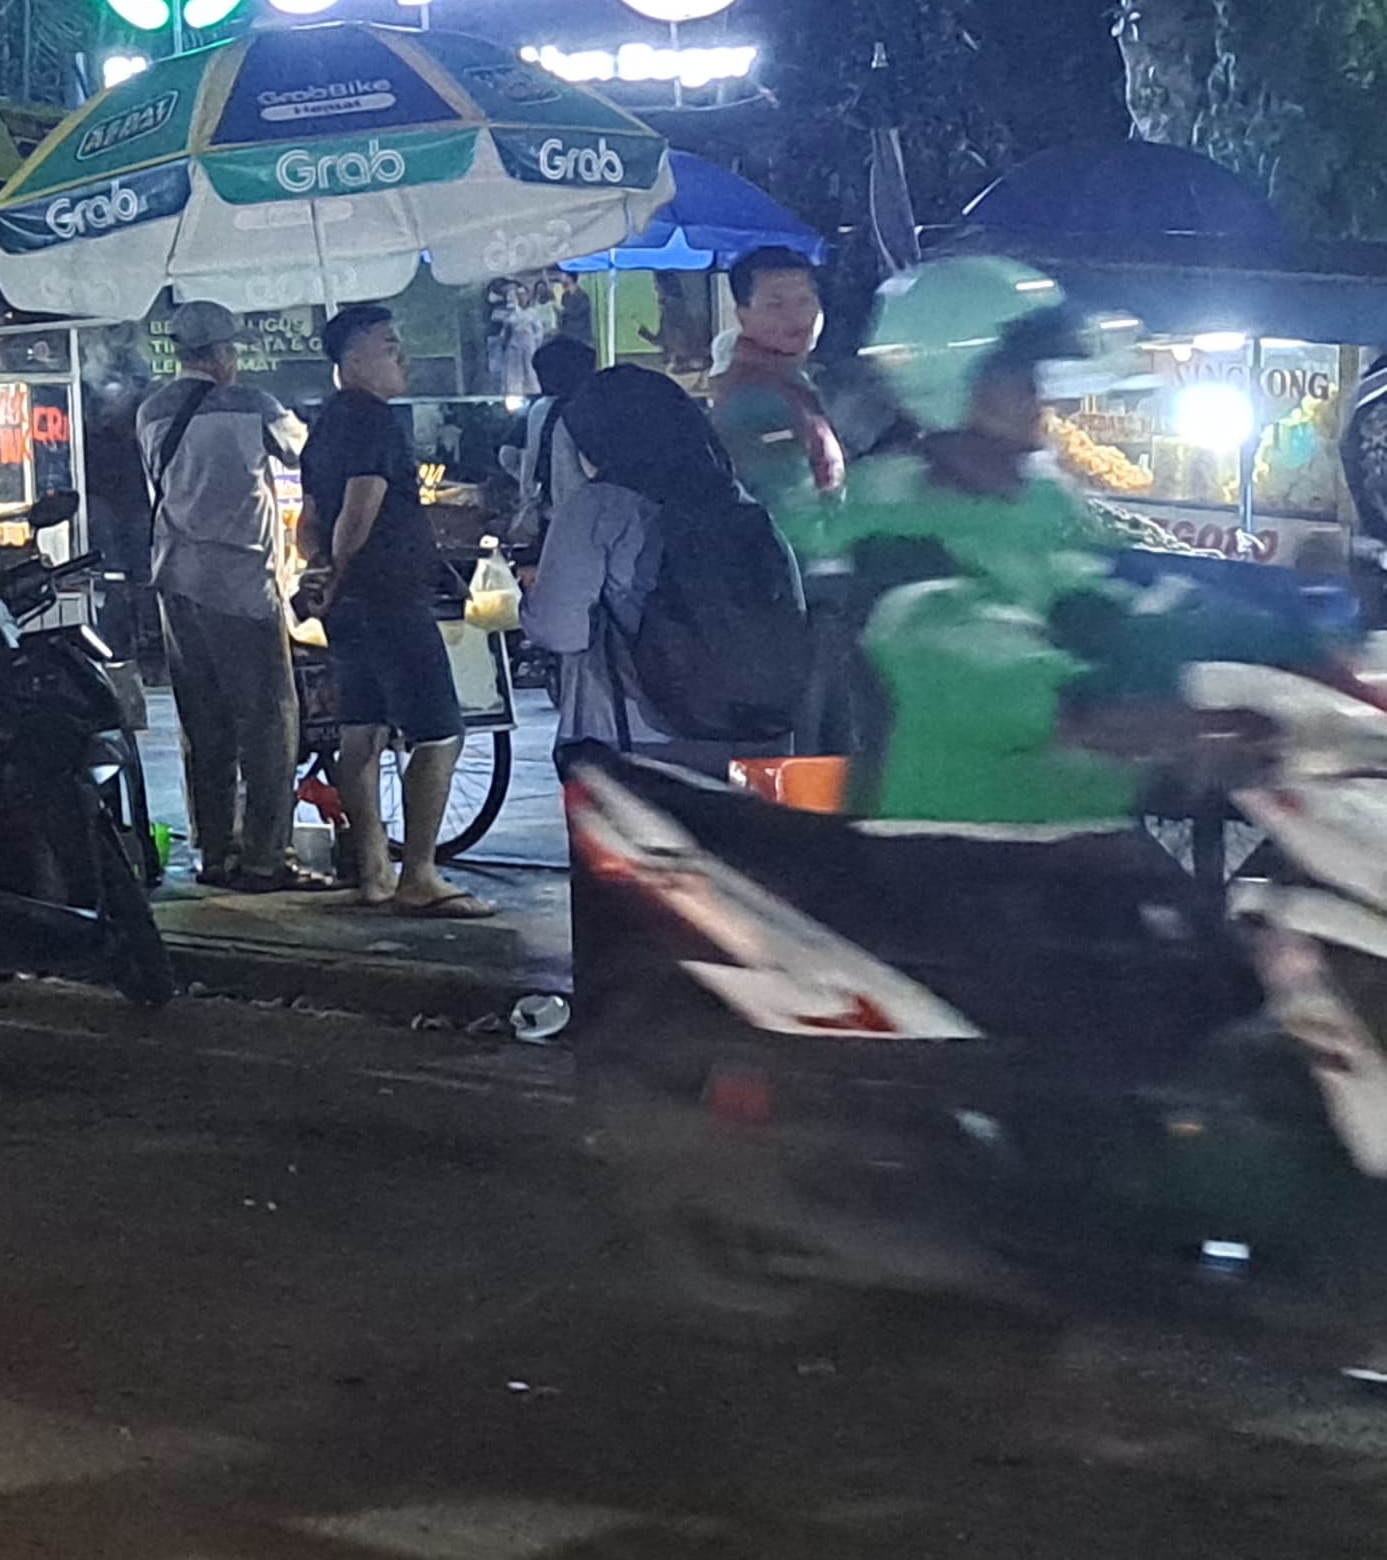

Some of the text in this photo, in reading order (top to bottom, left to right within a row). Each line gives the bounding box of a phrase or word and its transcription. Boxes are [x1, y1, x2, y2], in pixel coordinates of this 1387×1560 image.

[275, 139, 406, 192] Grab
[540, 138, 625, 182] Grab
[46, 180, 139, 238] Grab
